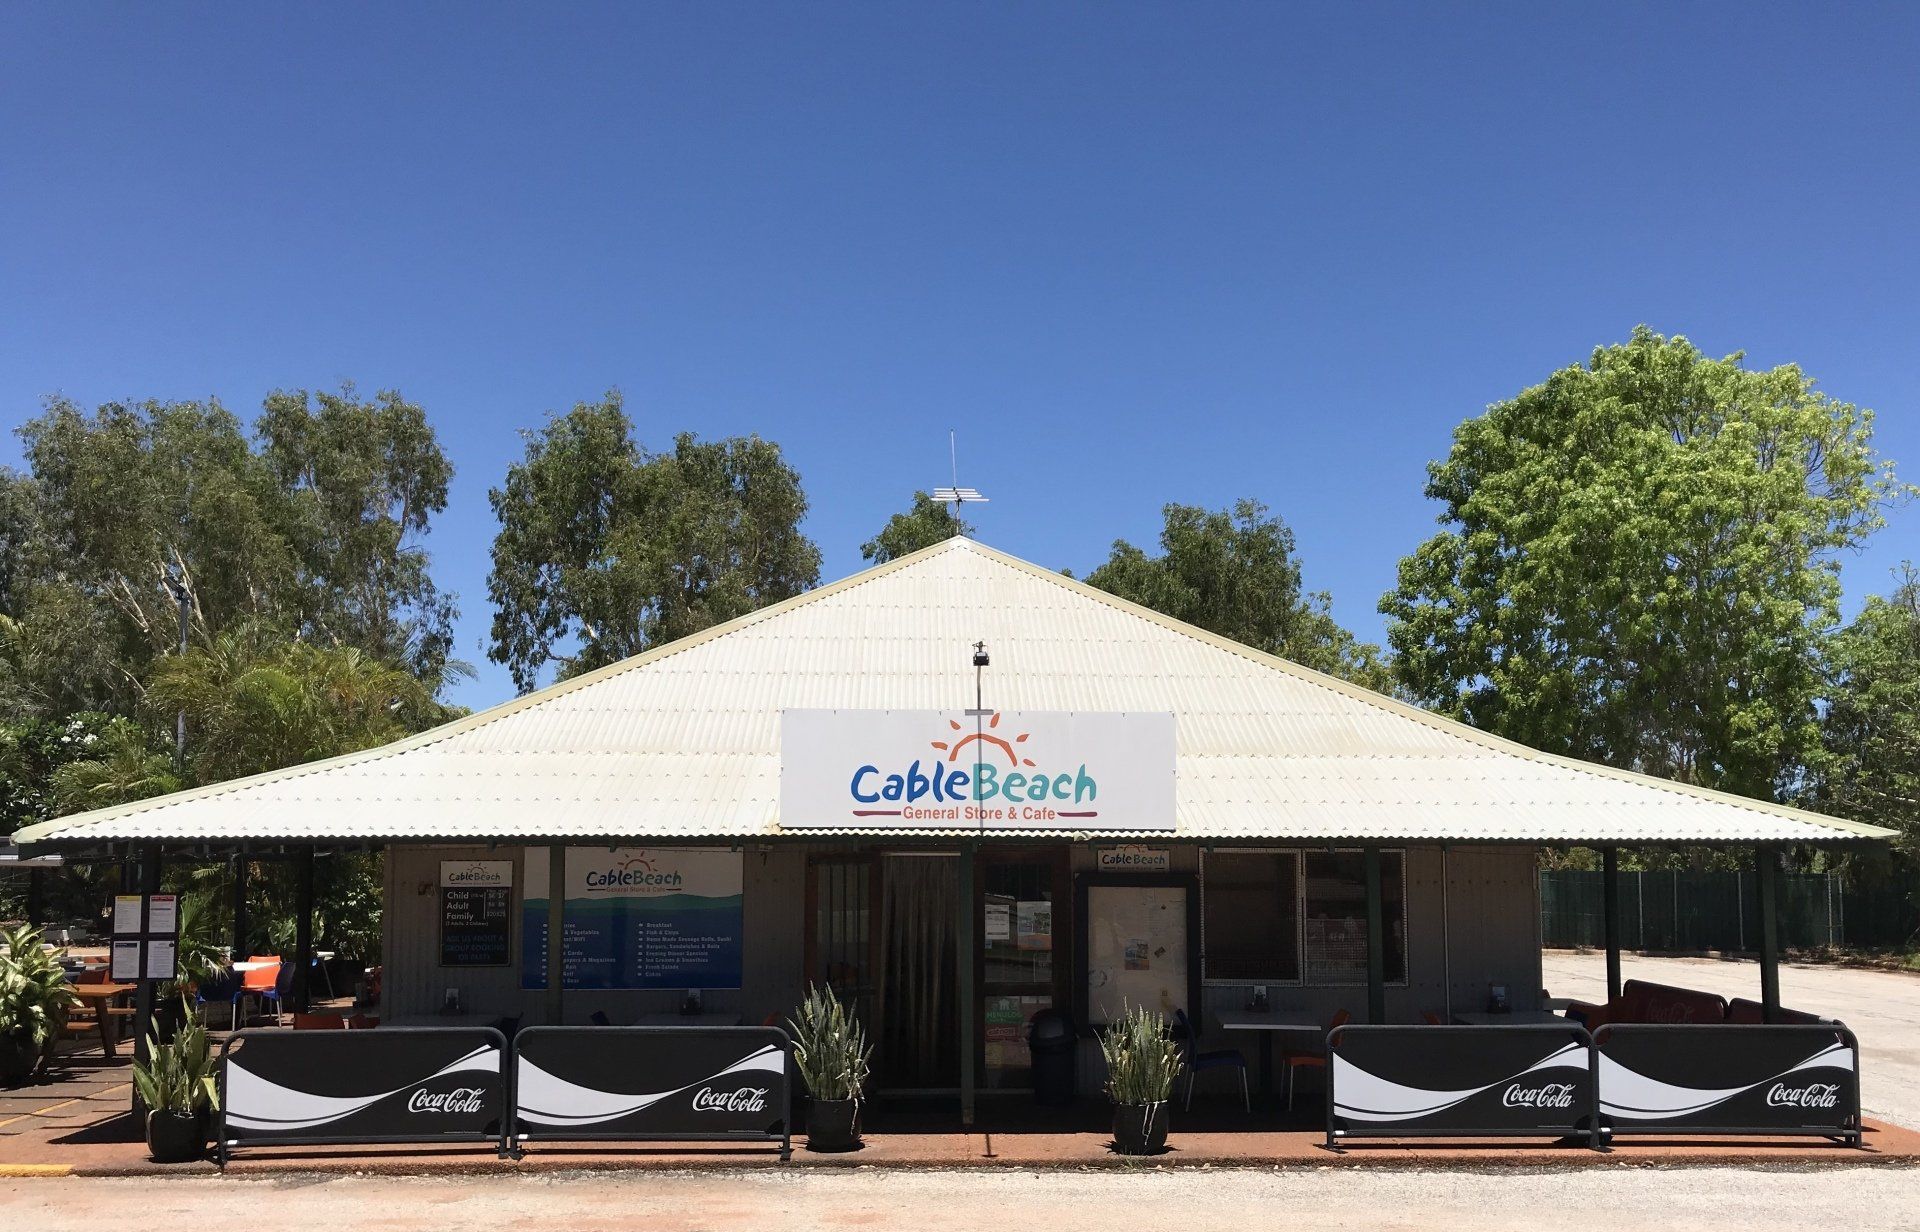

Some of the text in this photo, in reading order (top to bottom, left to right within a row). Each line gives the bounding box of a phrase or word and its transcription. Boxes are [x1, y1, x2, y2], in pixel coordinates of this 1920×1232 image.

[903, 806, 1056, 821] General Store & Cafe
[446, 902, 469, 910] Adult
[446, 912, 474, 921] Family
[407, 1088, 486, 1113] Coca-Cola
[692, 1086, 769, 1112] Coca-Cola
[1502, 1083, 1577, 1108] Coca-Cola
[1766, 1082, 1841, 1108] Coca-Cola
